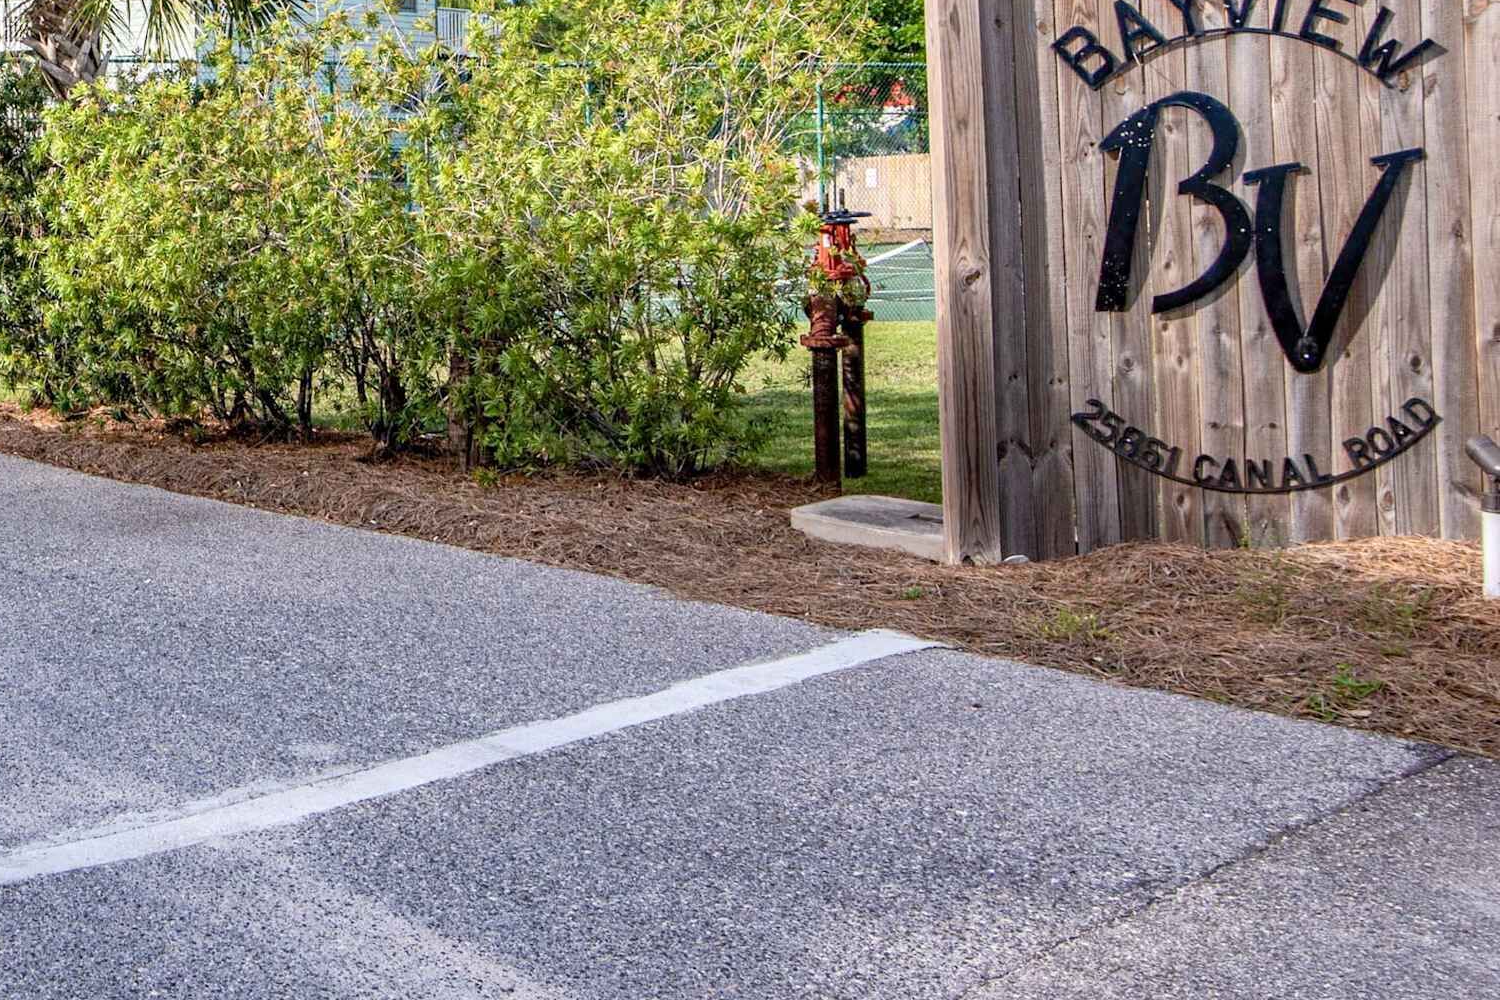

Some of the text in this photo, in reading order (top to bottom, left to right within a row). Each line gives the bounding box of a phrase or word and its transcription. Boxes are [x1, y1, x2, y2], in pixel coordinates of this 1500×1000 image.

[1096, 89, 1424, 374] BV
[1070, 397, 1444, 490] 25861 CANAL ROAD
